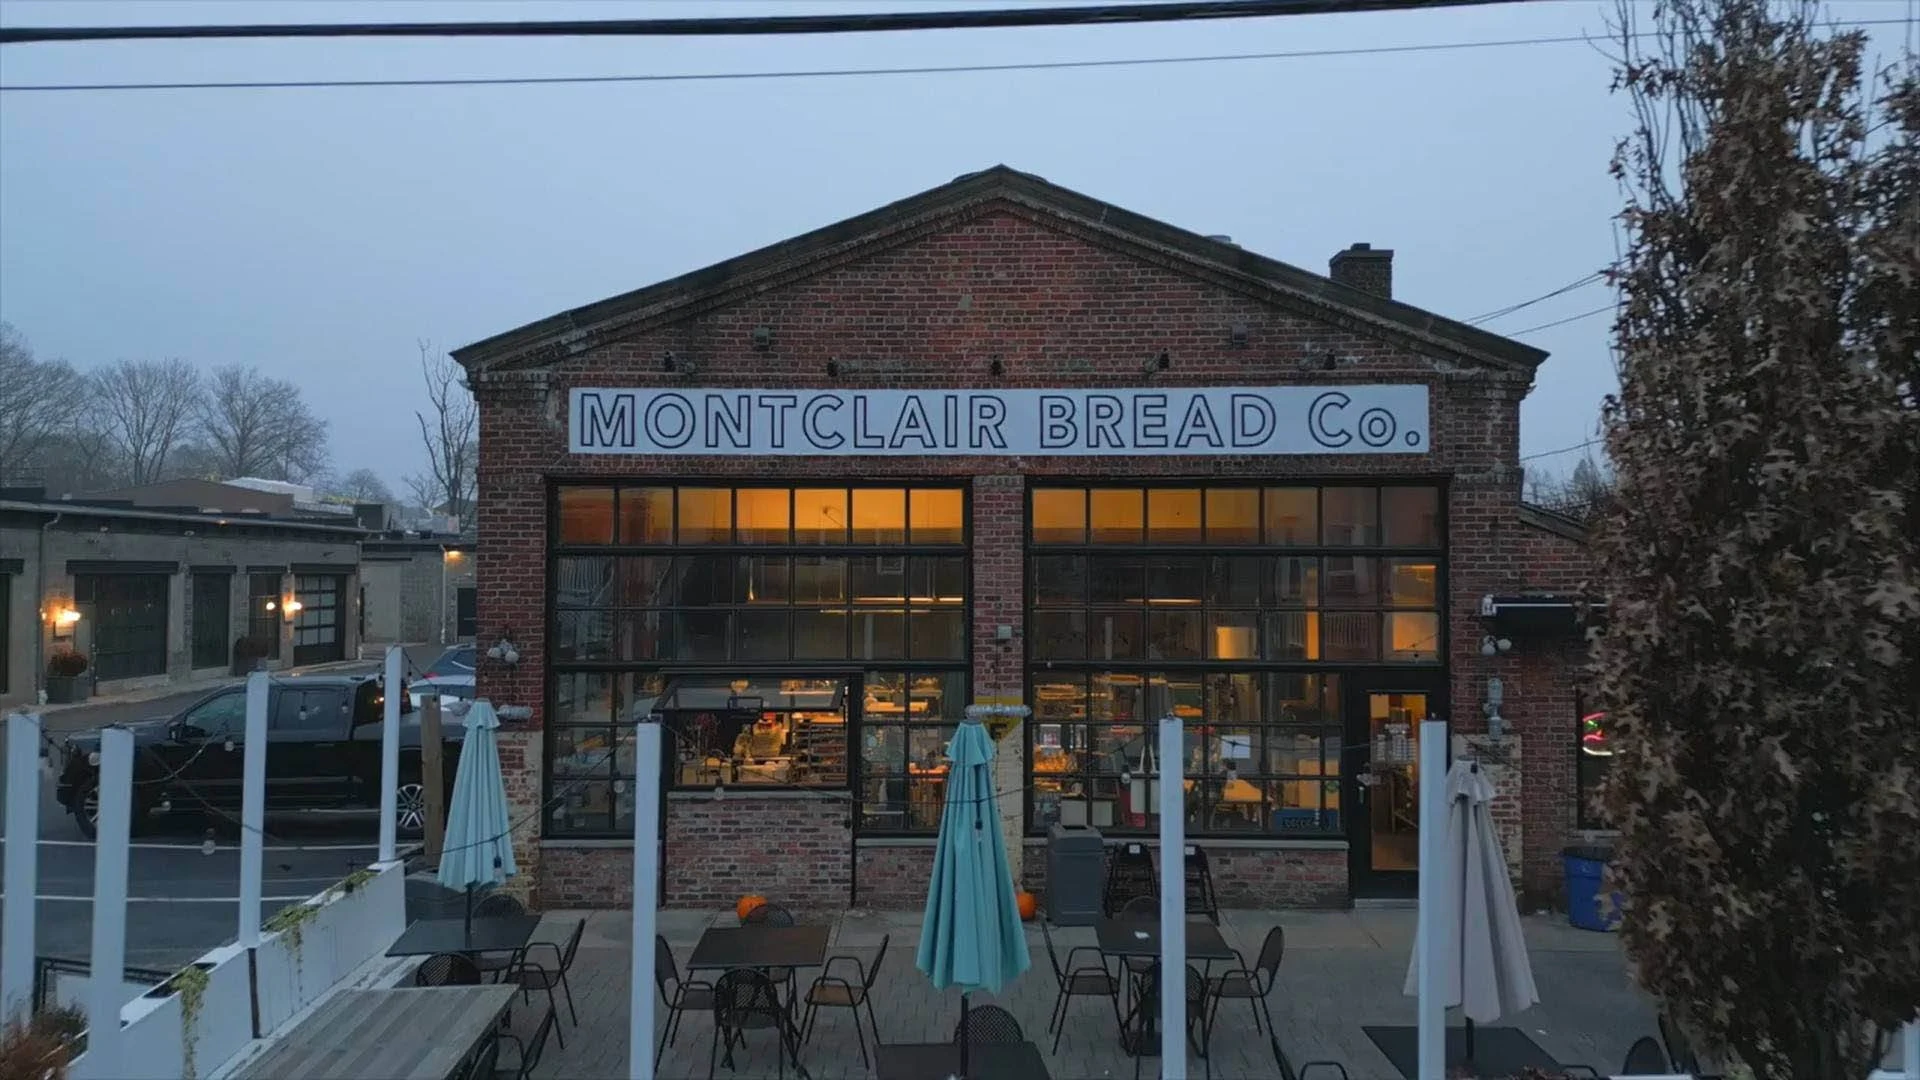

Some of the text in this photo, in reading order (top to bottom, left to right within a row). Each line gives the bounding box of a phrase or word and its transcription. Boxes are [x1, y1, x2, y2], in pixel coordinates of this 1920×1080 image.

[580, 391, 1421, 449] MONTCLAIR BREAD Co.
